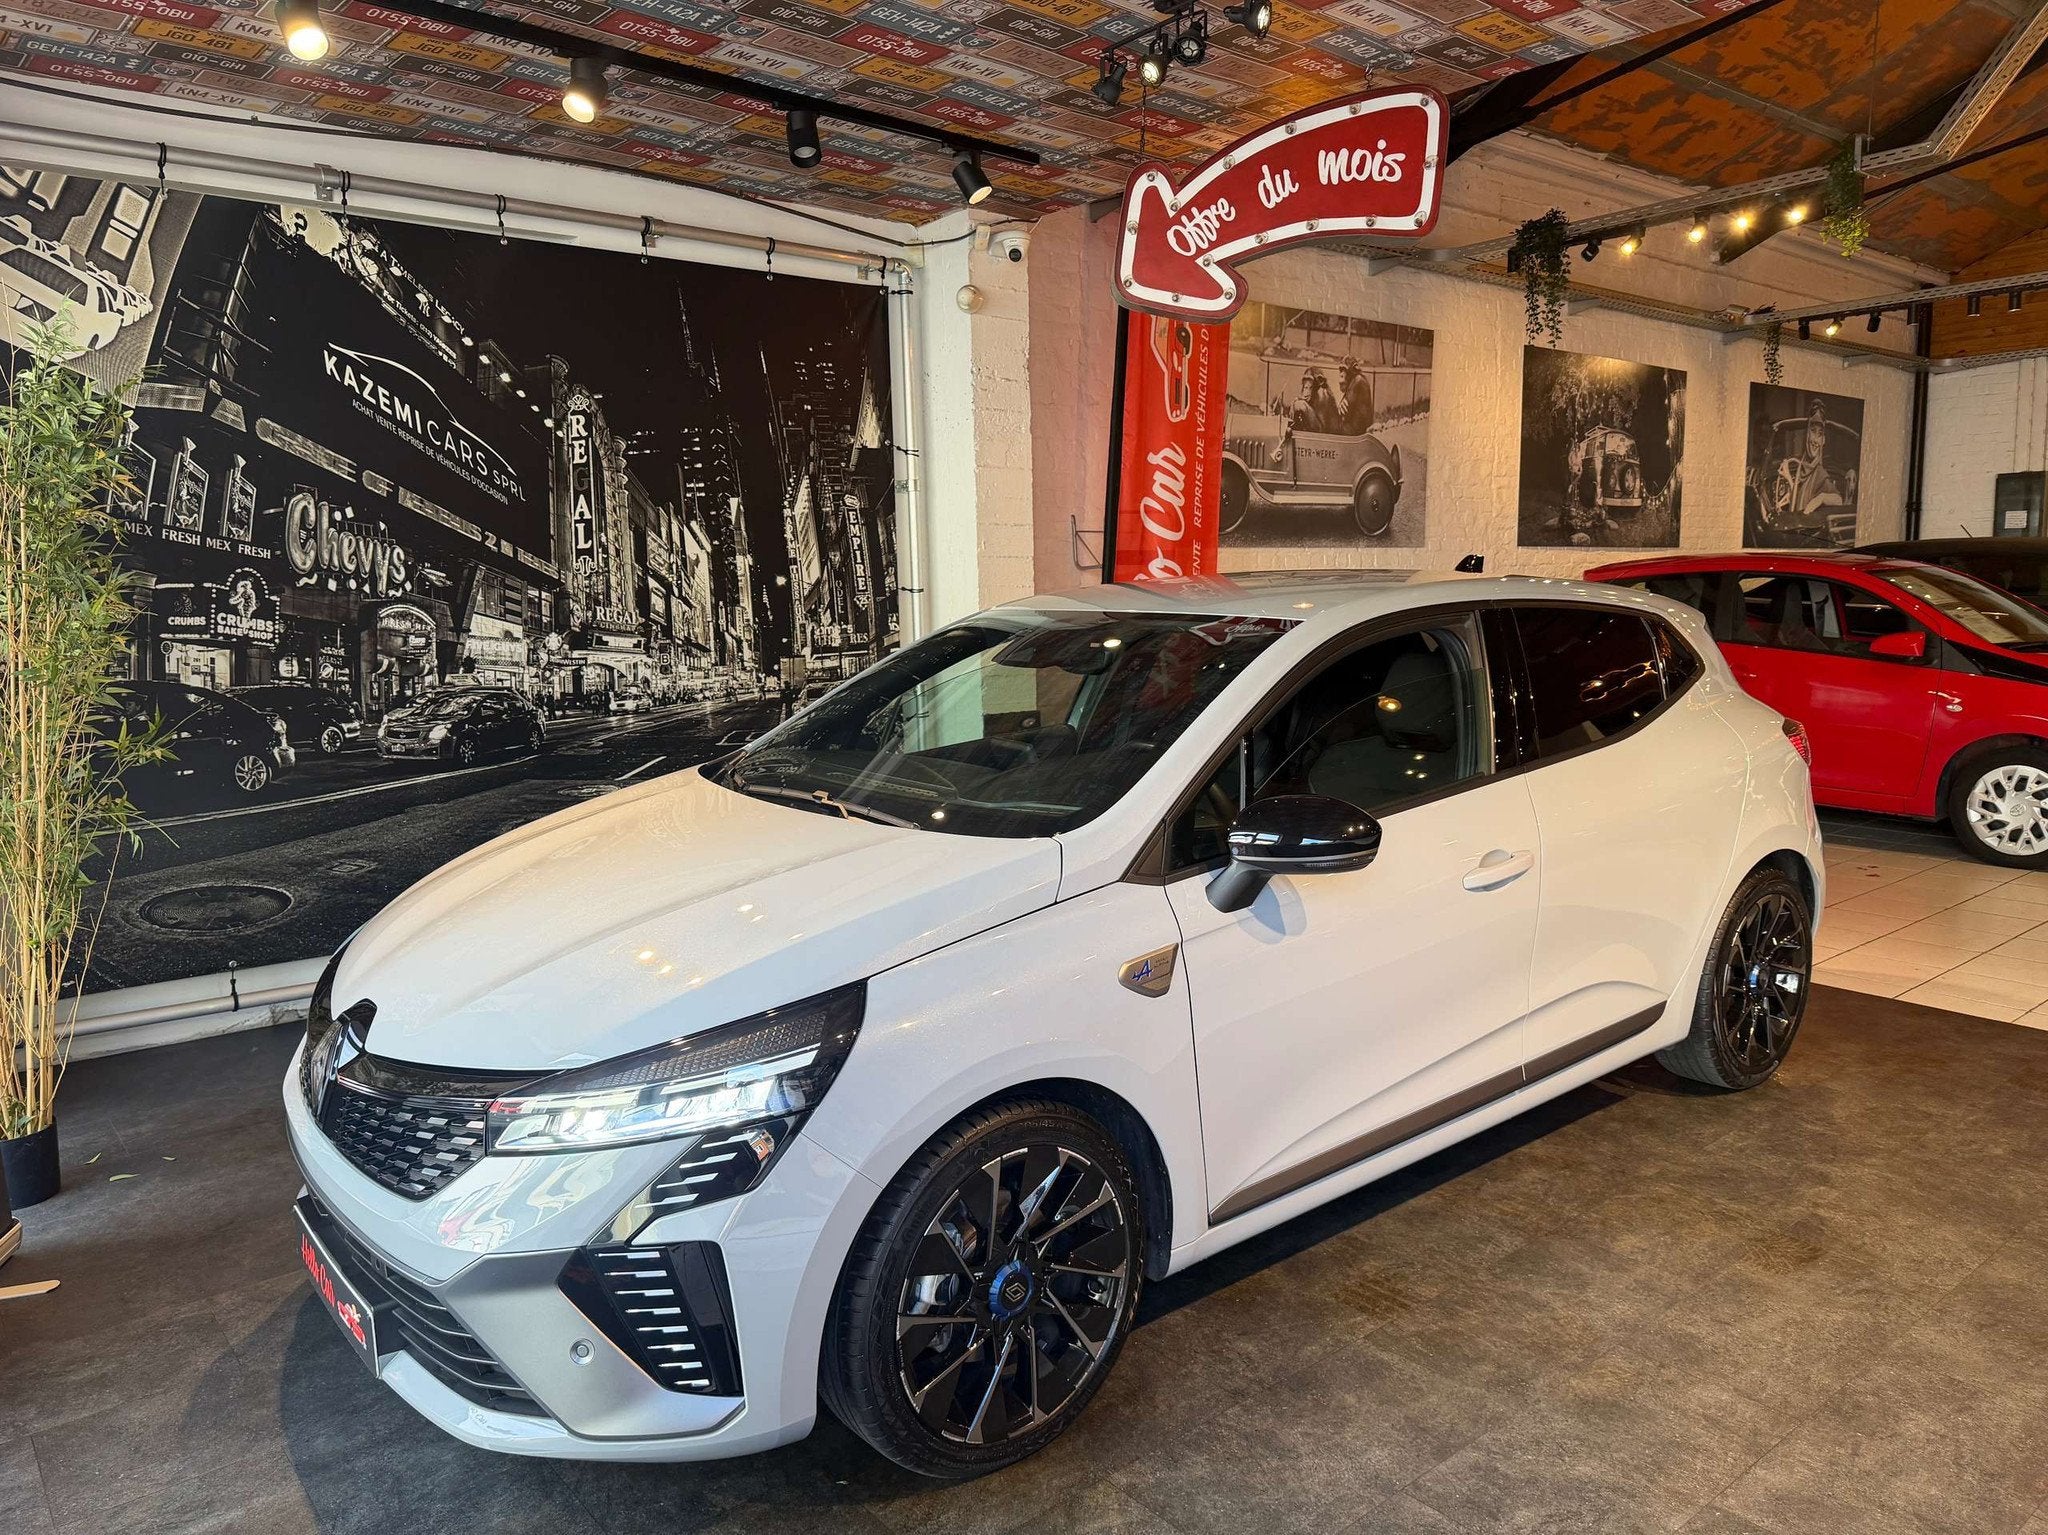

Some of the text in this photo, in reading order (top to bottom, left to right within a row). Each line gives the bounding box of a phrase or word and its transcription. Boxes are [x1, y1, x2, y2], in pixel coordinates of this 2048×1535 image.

[870, 6, 942, 34] GEH-142A
[26, 40, 117, 65] GEH-142A
[1166, 139, 1406, 257] Offre du mois
[1195, 344, 1209, 432] VÉHICULES
[323, 350, 527, 502] KAZEMI CARS SPRL
[352, 399, 374, 419] ACHAT
[375, 413, 398, 435] VENTE
[398, 427, 425, 452] REPRISE
[425, 445, 436, 457] DE
[471, 475, 509, 506] D'OCCASION
[1196, 436, 1205, 459] DE
[569, 414, 592, 550] REGAL
[1140, 442, 1187, 541] Car
[1194, 467, 1204, 528] REPRISE
[124, 521, 271, 560] MEX FRESH MEX FRESH
[285, 492, 406, 598] Chevys
[849, 511, 867, 591] EMPIRE
[168, 616, 207, 626] CRUMBS
[216, 612, 274, 633] CRUMBS
[217, 625, 274, 641] BAKE SHOP
[595, 606, 639, 624] REGAL
